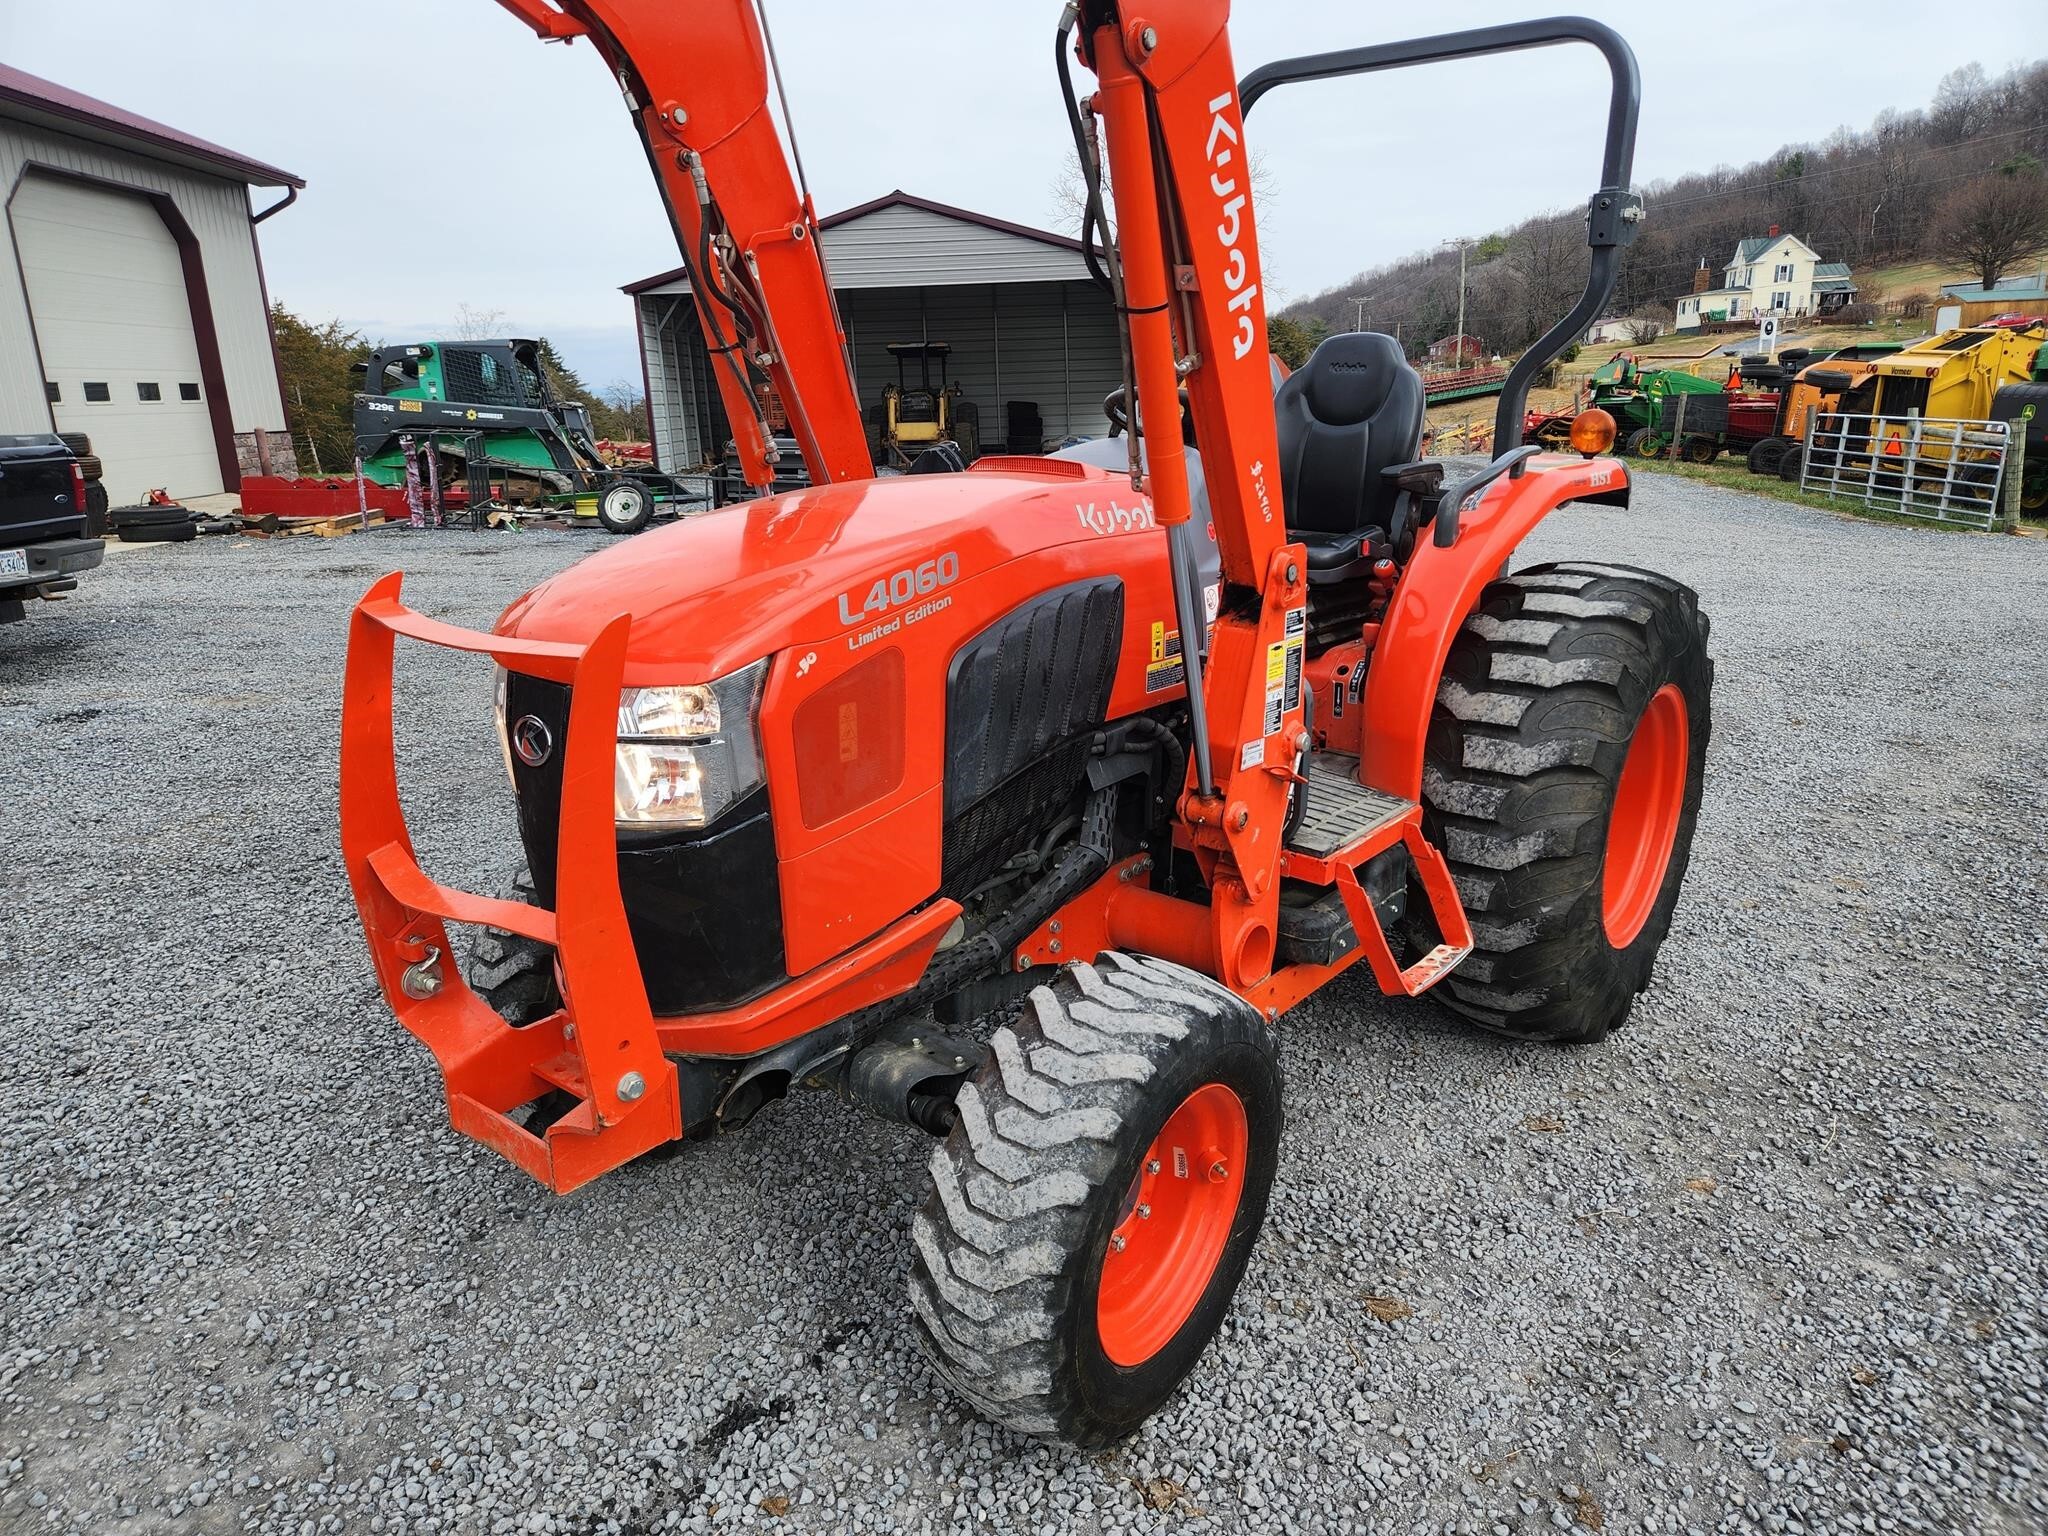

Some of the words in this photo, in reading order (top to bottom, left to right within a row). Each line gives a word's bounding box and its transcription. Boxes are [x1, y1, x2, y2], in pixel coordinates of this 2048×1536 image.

[1206, 91, 1258, 361] Kubota
[1891, 366, 1912, 375] Vermeer
[368, 402, 395, 412] 329E
[1075, 498, 1155, 535] Kubot
[838, 551, 959, 625] L4060
[848, 616, 901, 650] Limited
[904, 595, 953, 625] Edition
